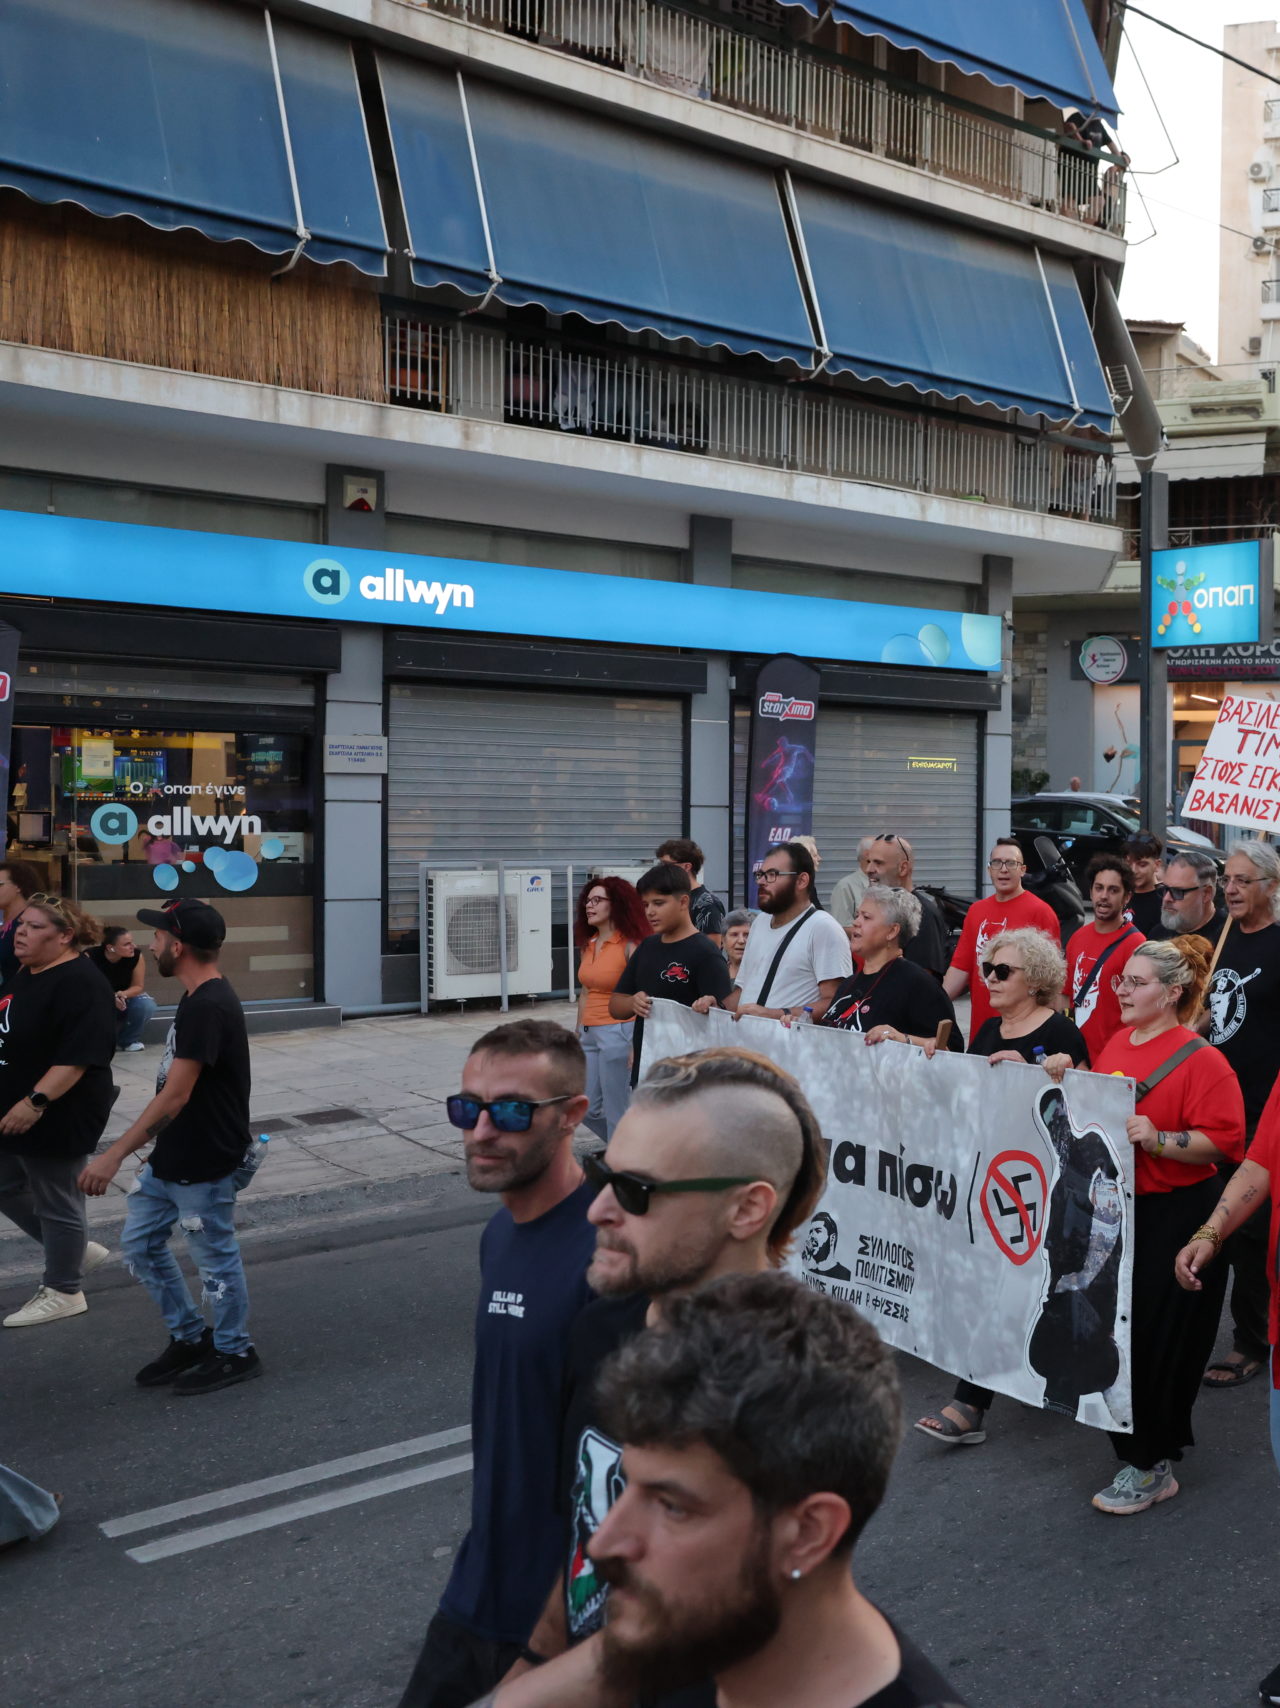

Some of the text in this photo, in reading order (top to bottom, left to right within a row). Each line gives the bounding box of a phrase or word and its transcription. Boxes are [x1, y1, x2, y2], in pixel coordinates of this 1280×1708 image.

[359, 567, 475, 615] allwyn
[1194, 756, 1248, 786] ΣΤΟΥΣ
[205, 782, 246, 798] έγινε
[147, 806, 262, 844] allwyn
[878, 1142, 958, 1221] πίσω
[857, 1234, 915, 1272] ΣΥΛΛΟΓΟΣ
[831, 1284, 863, 1306] KILLAH
[855, 1259, 915, 1295] ΠΟΛΙΤΙΣΜΟΥ
